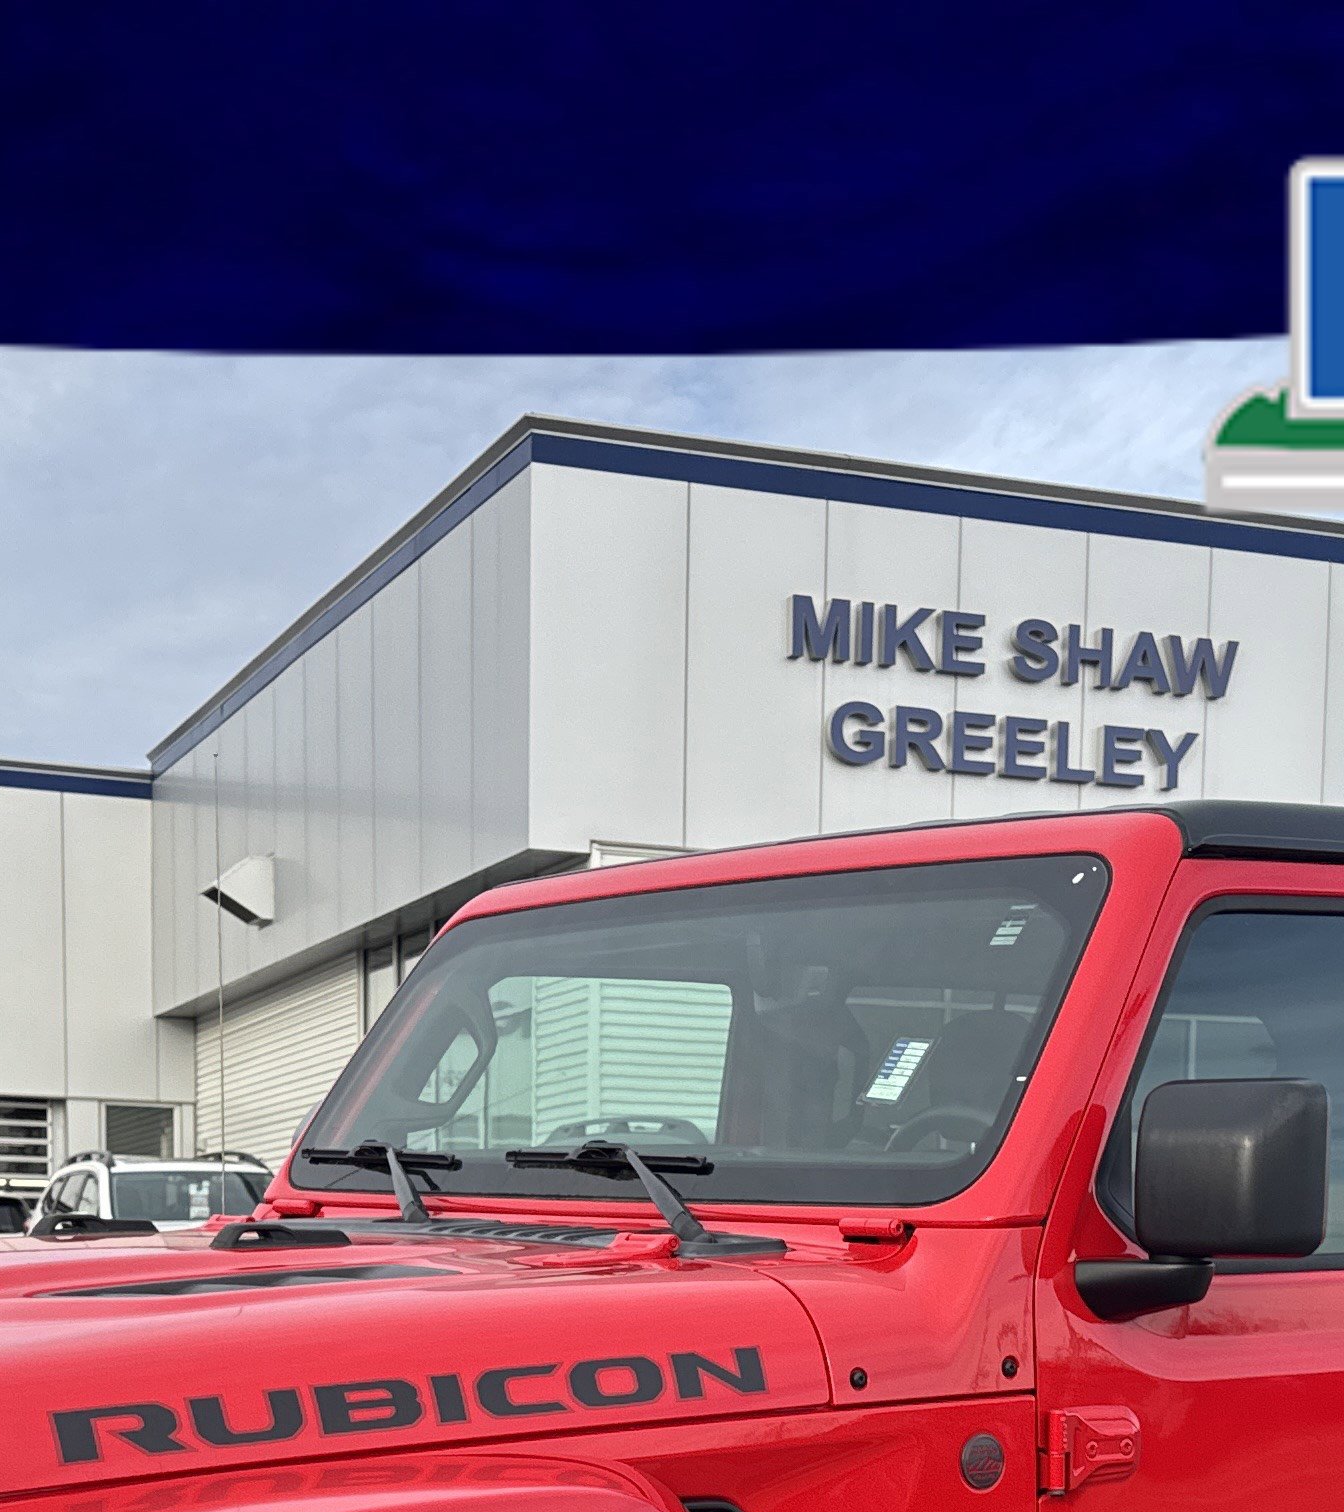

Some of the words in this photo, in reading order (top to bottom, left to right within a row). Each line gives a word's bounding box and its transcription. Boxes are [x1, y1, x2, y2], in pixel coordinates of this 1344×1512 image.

[787, 594, 986, 677] MIKE
[1007, 618, 1239, 700] SHAW
[828, 701, 1198, 791] GREELEY
[51, 1345, 769, 1466] RUBICON
